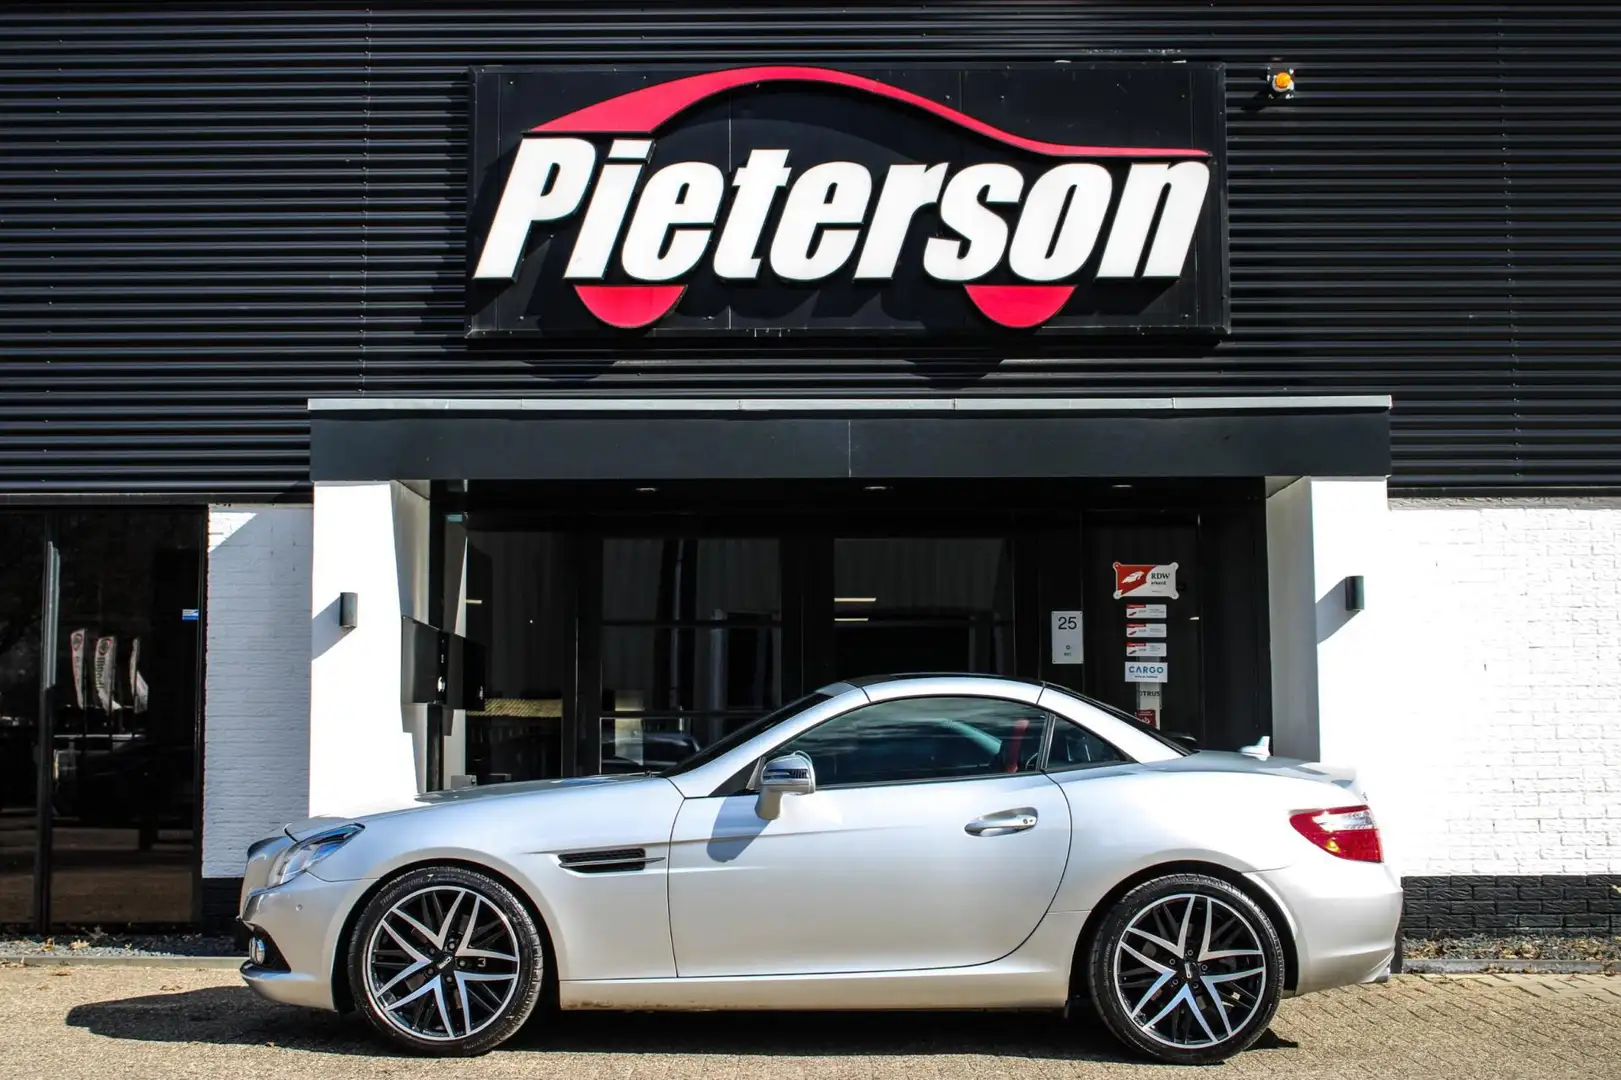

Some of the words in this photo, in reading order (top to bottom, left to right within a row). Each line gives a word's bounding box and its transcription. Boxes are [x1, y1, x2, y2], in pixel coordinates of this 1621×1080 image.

[473, 136, 1210, 281] Pieterson
[1151, 572, 1170, 580] RDW
[1058, 616, 1077, 630] 25
[1128, 665, 1164, 674] CARGO
